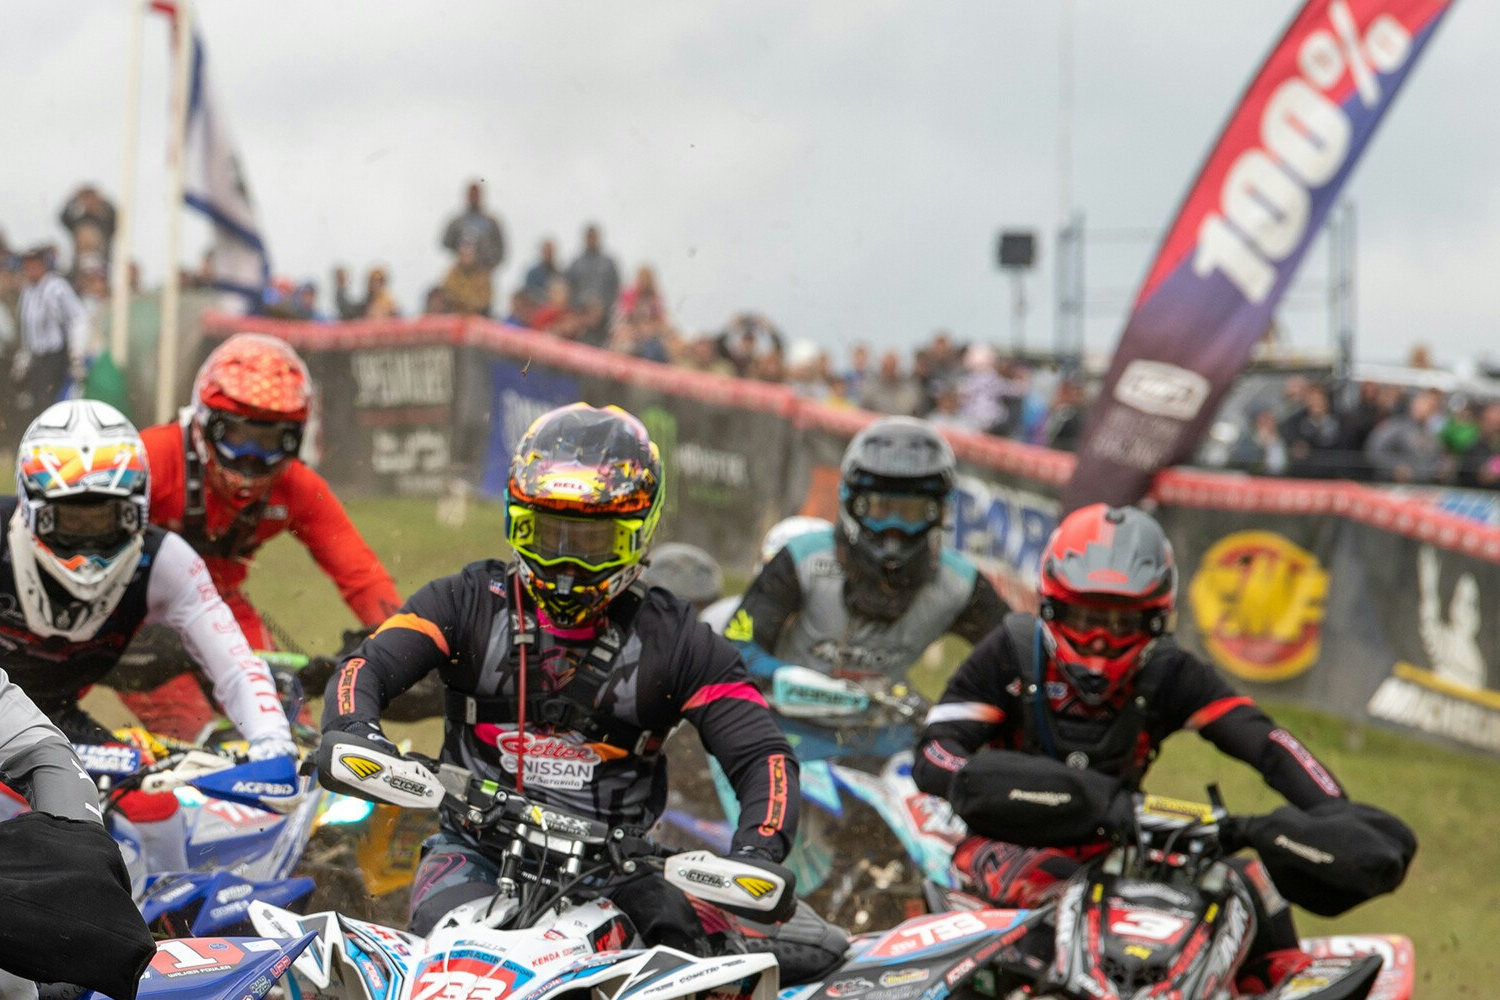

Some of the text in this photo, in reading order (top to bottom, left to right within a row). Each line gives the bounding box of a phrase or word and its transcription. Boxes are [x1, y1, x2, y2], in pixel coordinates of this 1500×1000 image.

[1192, 0, 1411, 304] 100%
[553, 482, 584, 490] BELL
[523, 761, 591, 778] NISSAN
[902, 911, 988, 946] 733
[1111, 912, 1184, 941] 3
[156, 940, 218, 969] 1
[532, 952, 560, 968] KENDA
